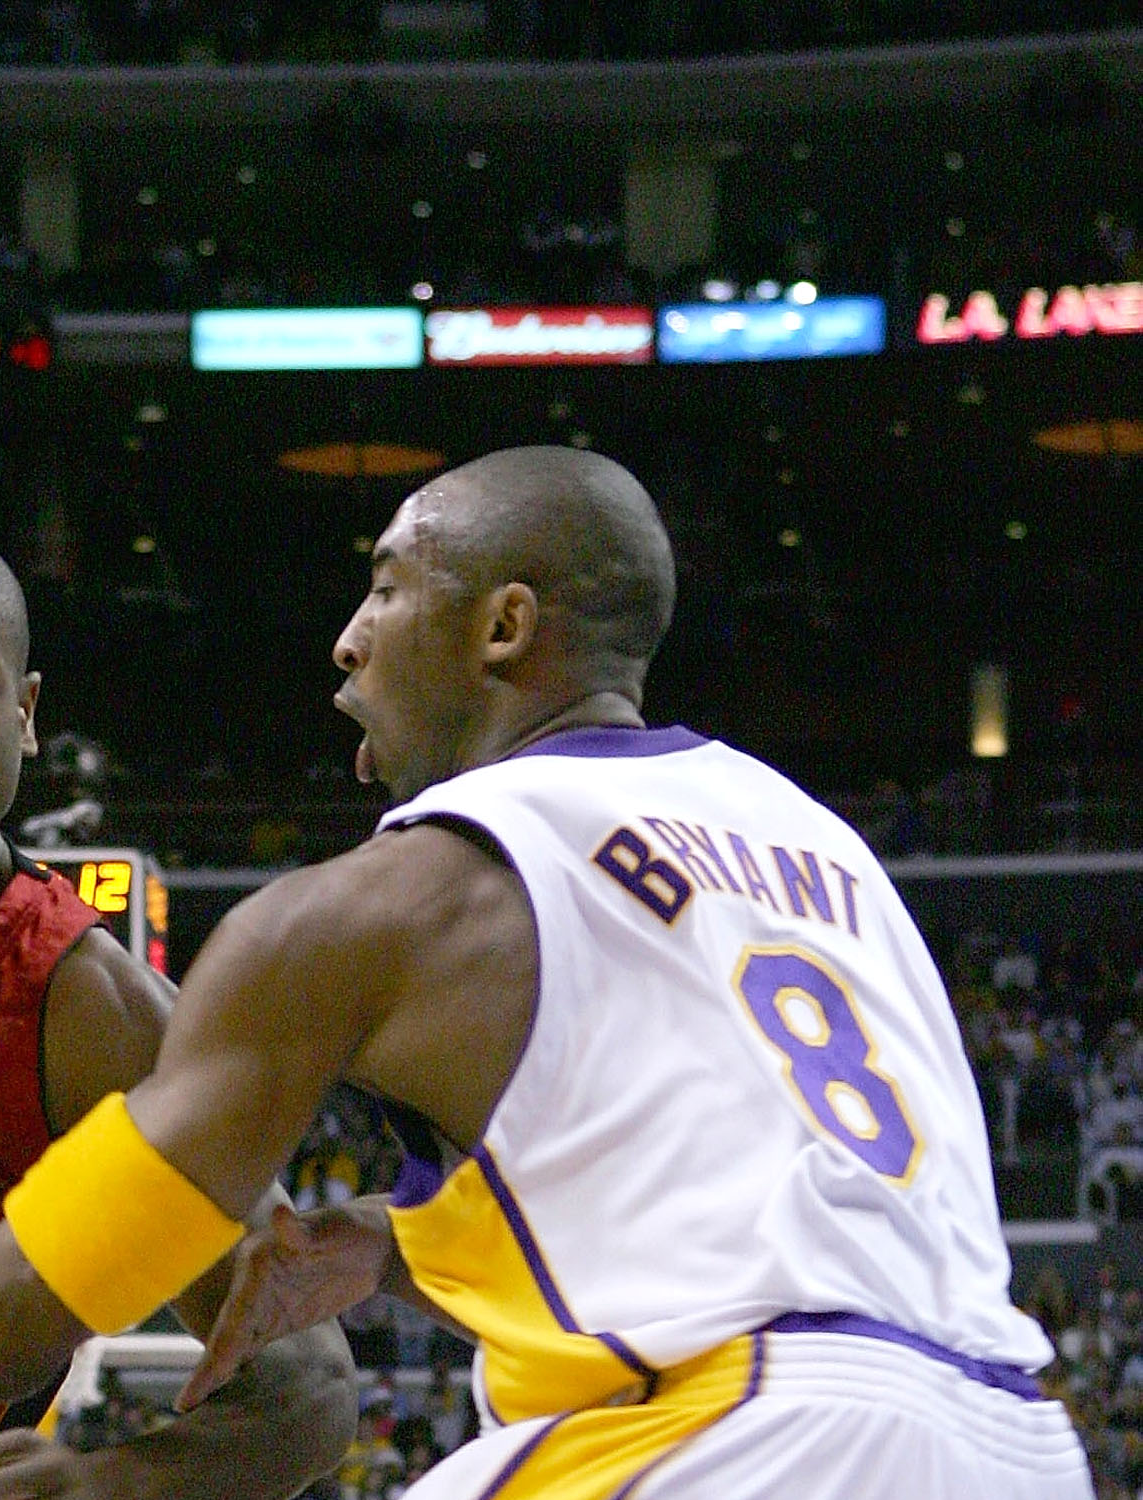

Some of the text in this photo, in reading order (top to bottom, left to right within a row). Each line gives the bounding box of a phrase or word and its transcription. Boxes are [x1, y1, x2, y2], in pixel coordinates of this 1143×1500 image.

[78, 860, 133, 913] 12
[589, 815, 861, 941] BRYANT
[730, 943, 926, 1190] 8
